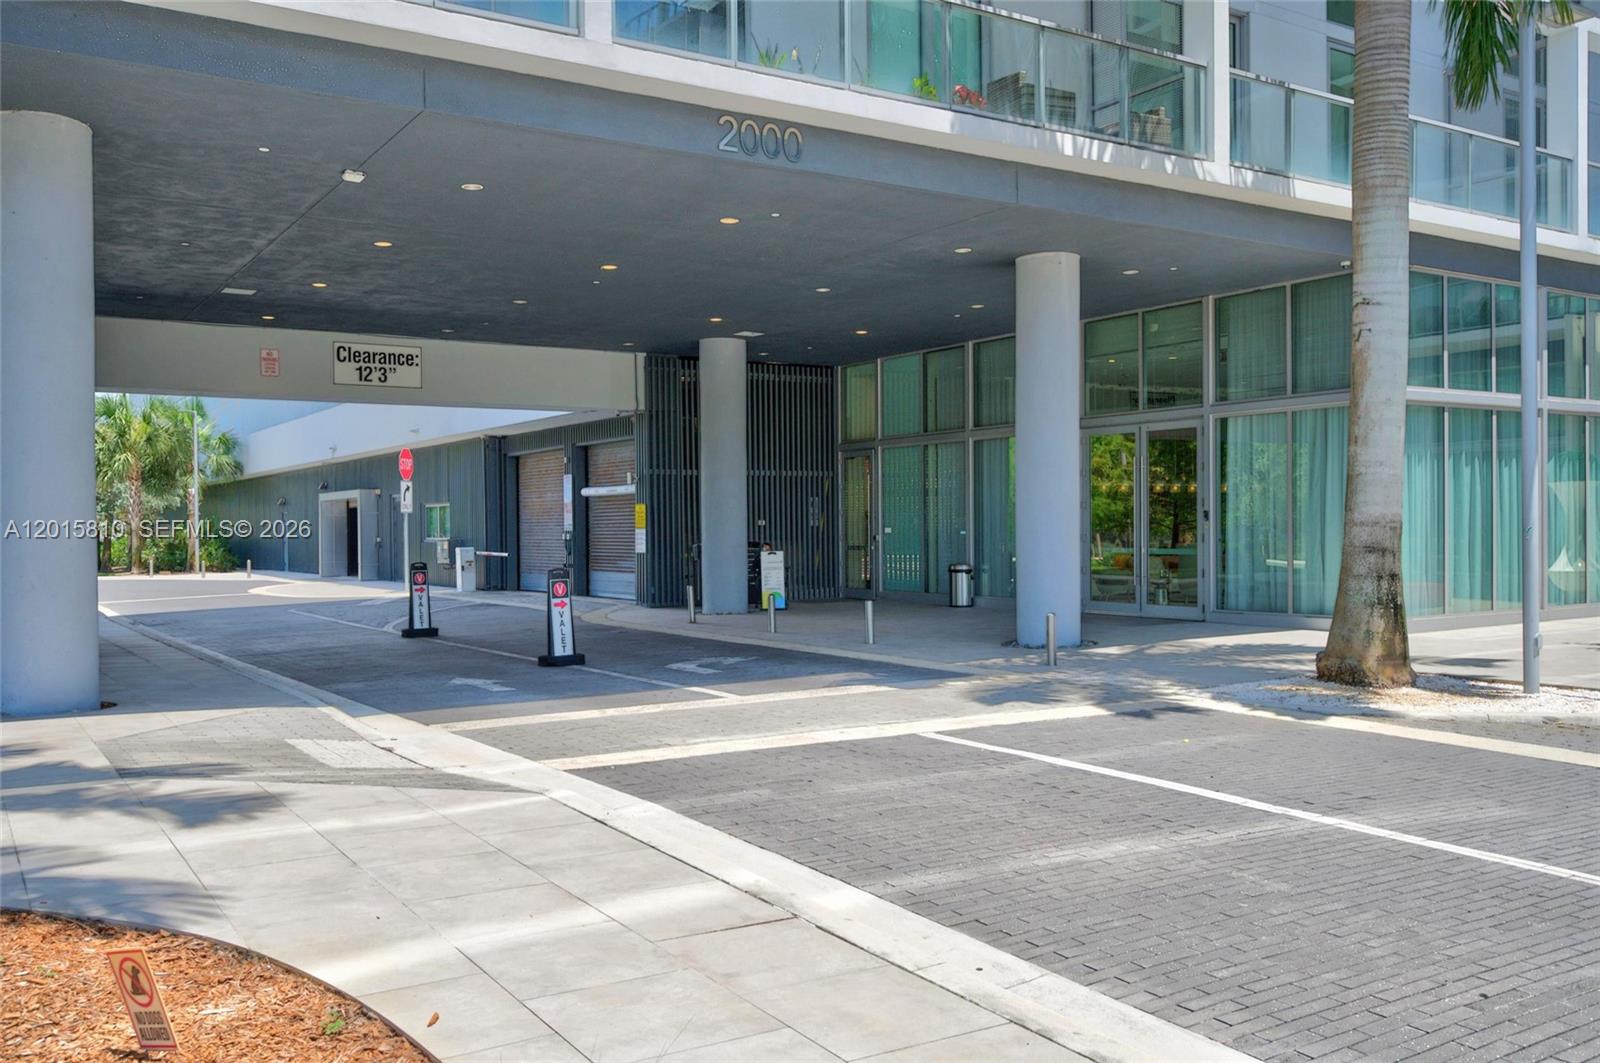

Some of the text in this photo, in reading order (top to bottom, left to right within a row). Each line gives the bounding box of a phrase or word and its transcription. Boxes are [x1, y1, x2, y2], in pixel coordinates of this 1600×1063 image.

[718, 114, 803, 163] 2000
[336, 345, 419, 367] Clearance:
[400, 458, 413, 470] STOP
[558, 610, 567, 653] VALET
[139, 1027, 170, 1040] ALLOWED
